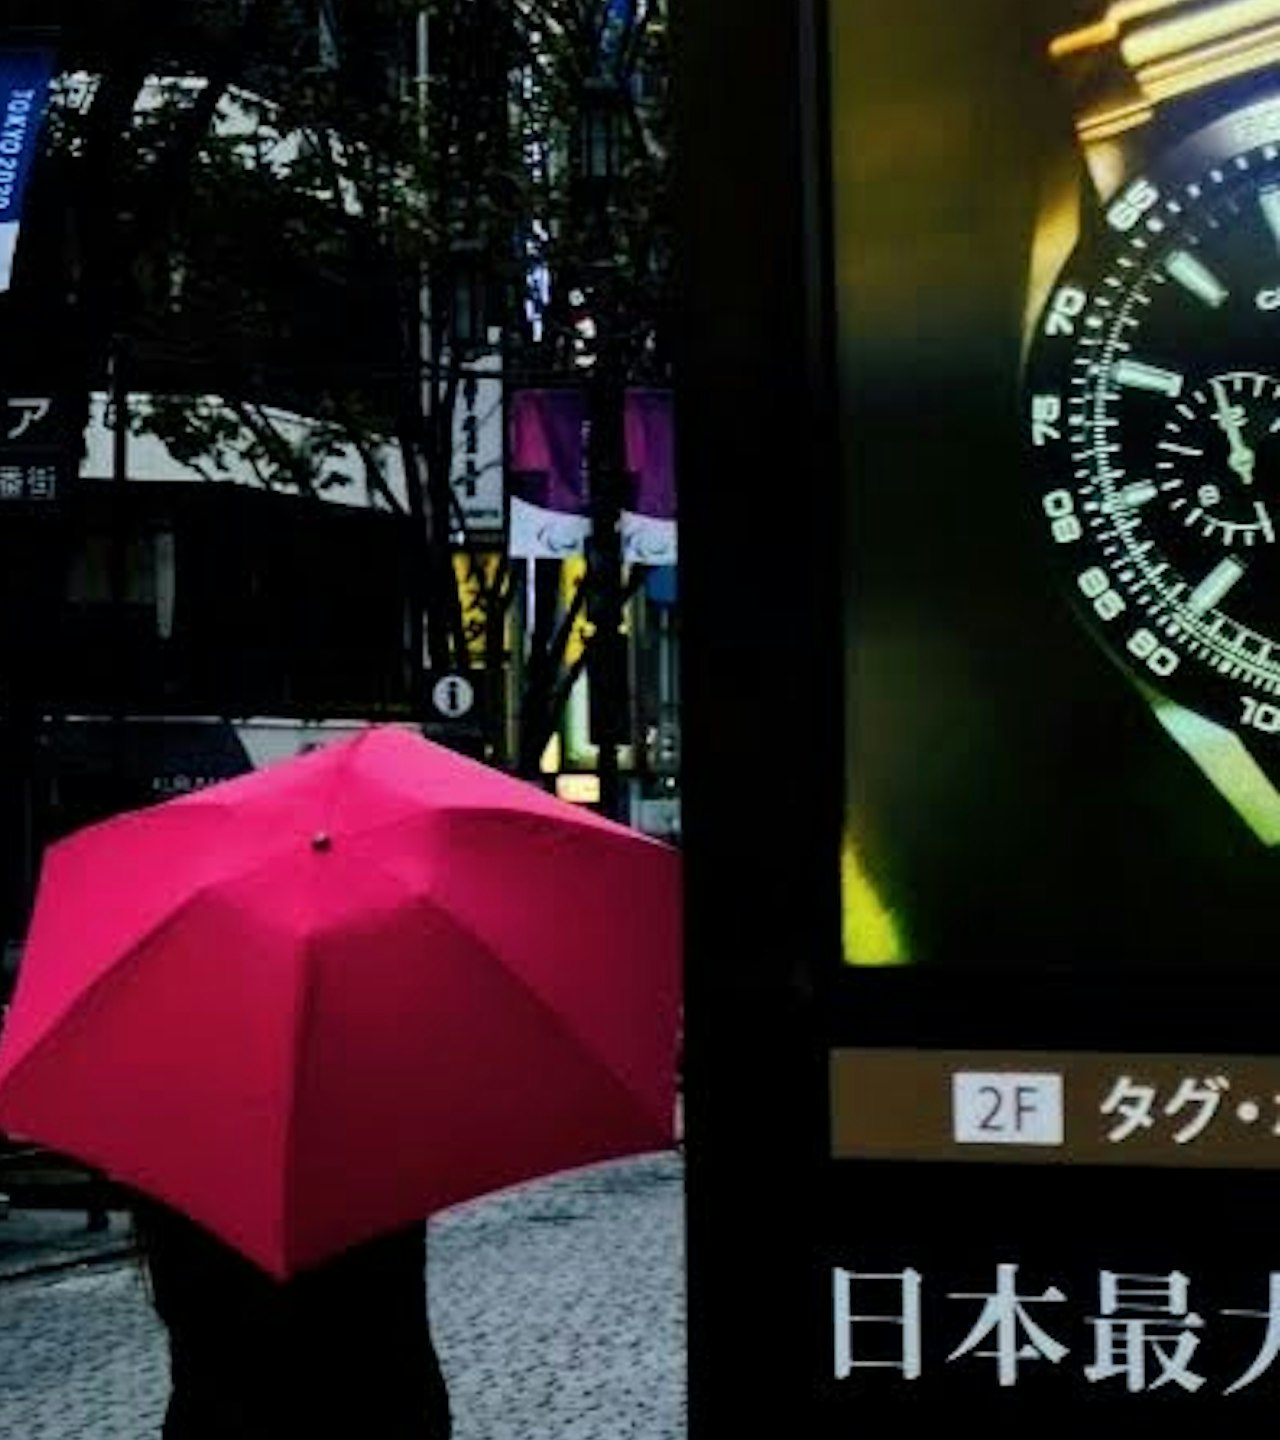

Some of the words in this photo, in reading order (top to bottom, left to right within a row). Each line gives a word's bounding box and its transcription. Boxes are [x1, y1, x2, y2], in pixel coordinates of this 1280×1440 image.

[1045, 284, 1086, 337] 70
[1031, 392, 1061, 446] 75
[1042, 485, 1082, 544] 80
[977, 1086, 1039, 1133] 2F
[1099, 1074, 1280, 1145] タグ・
